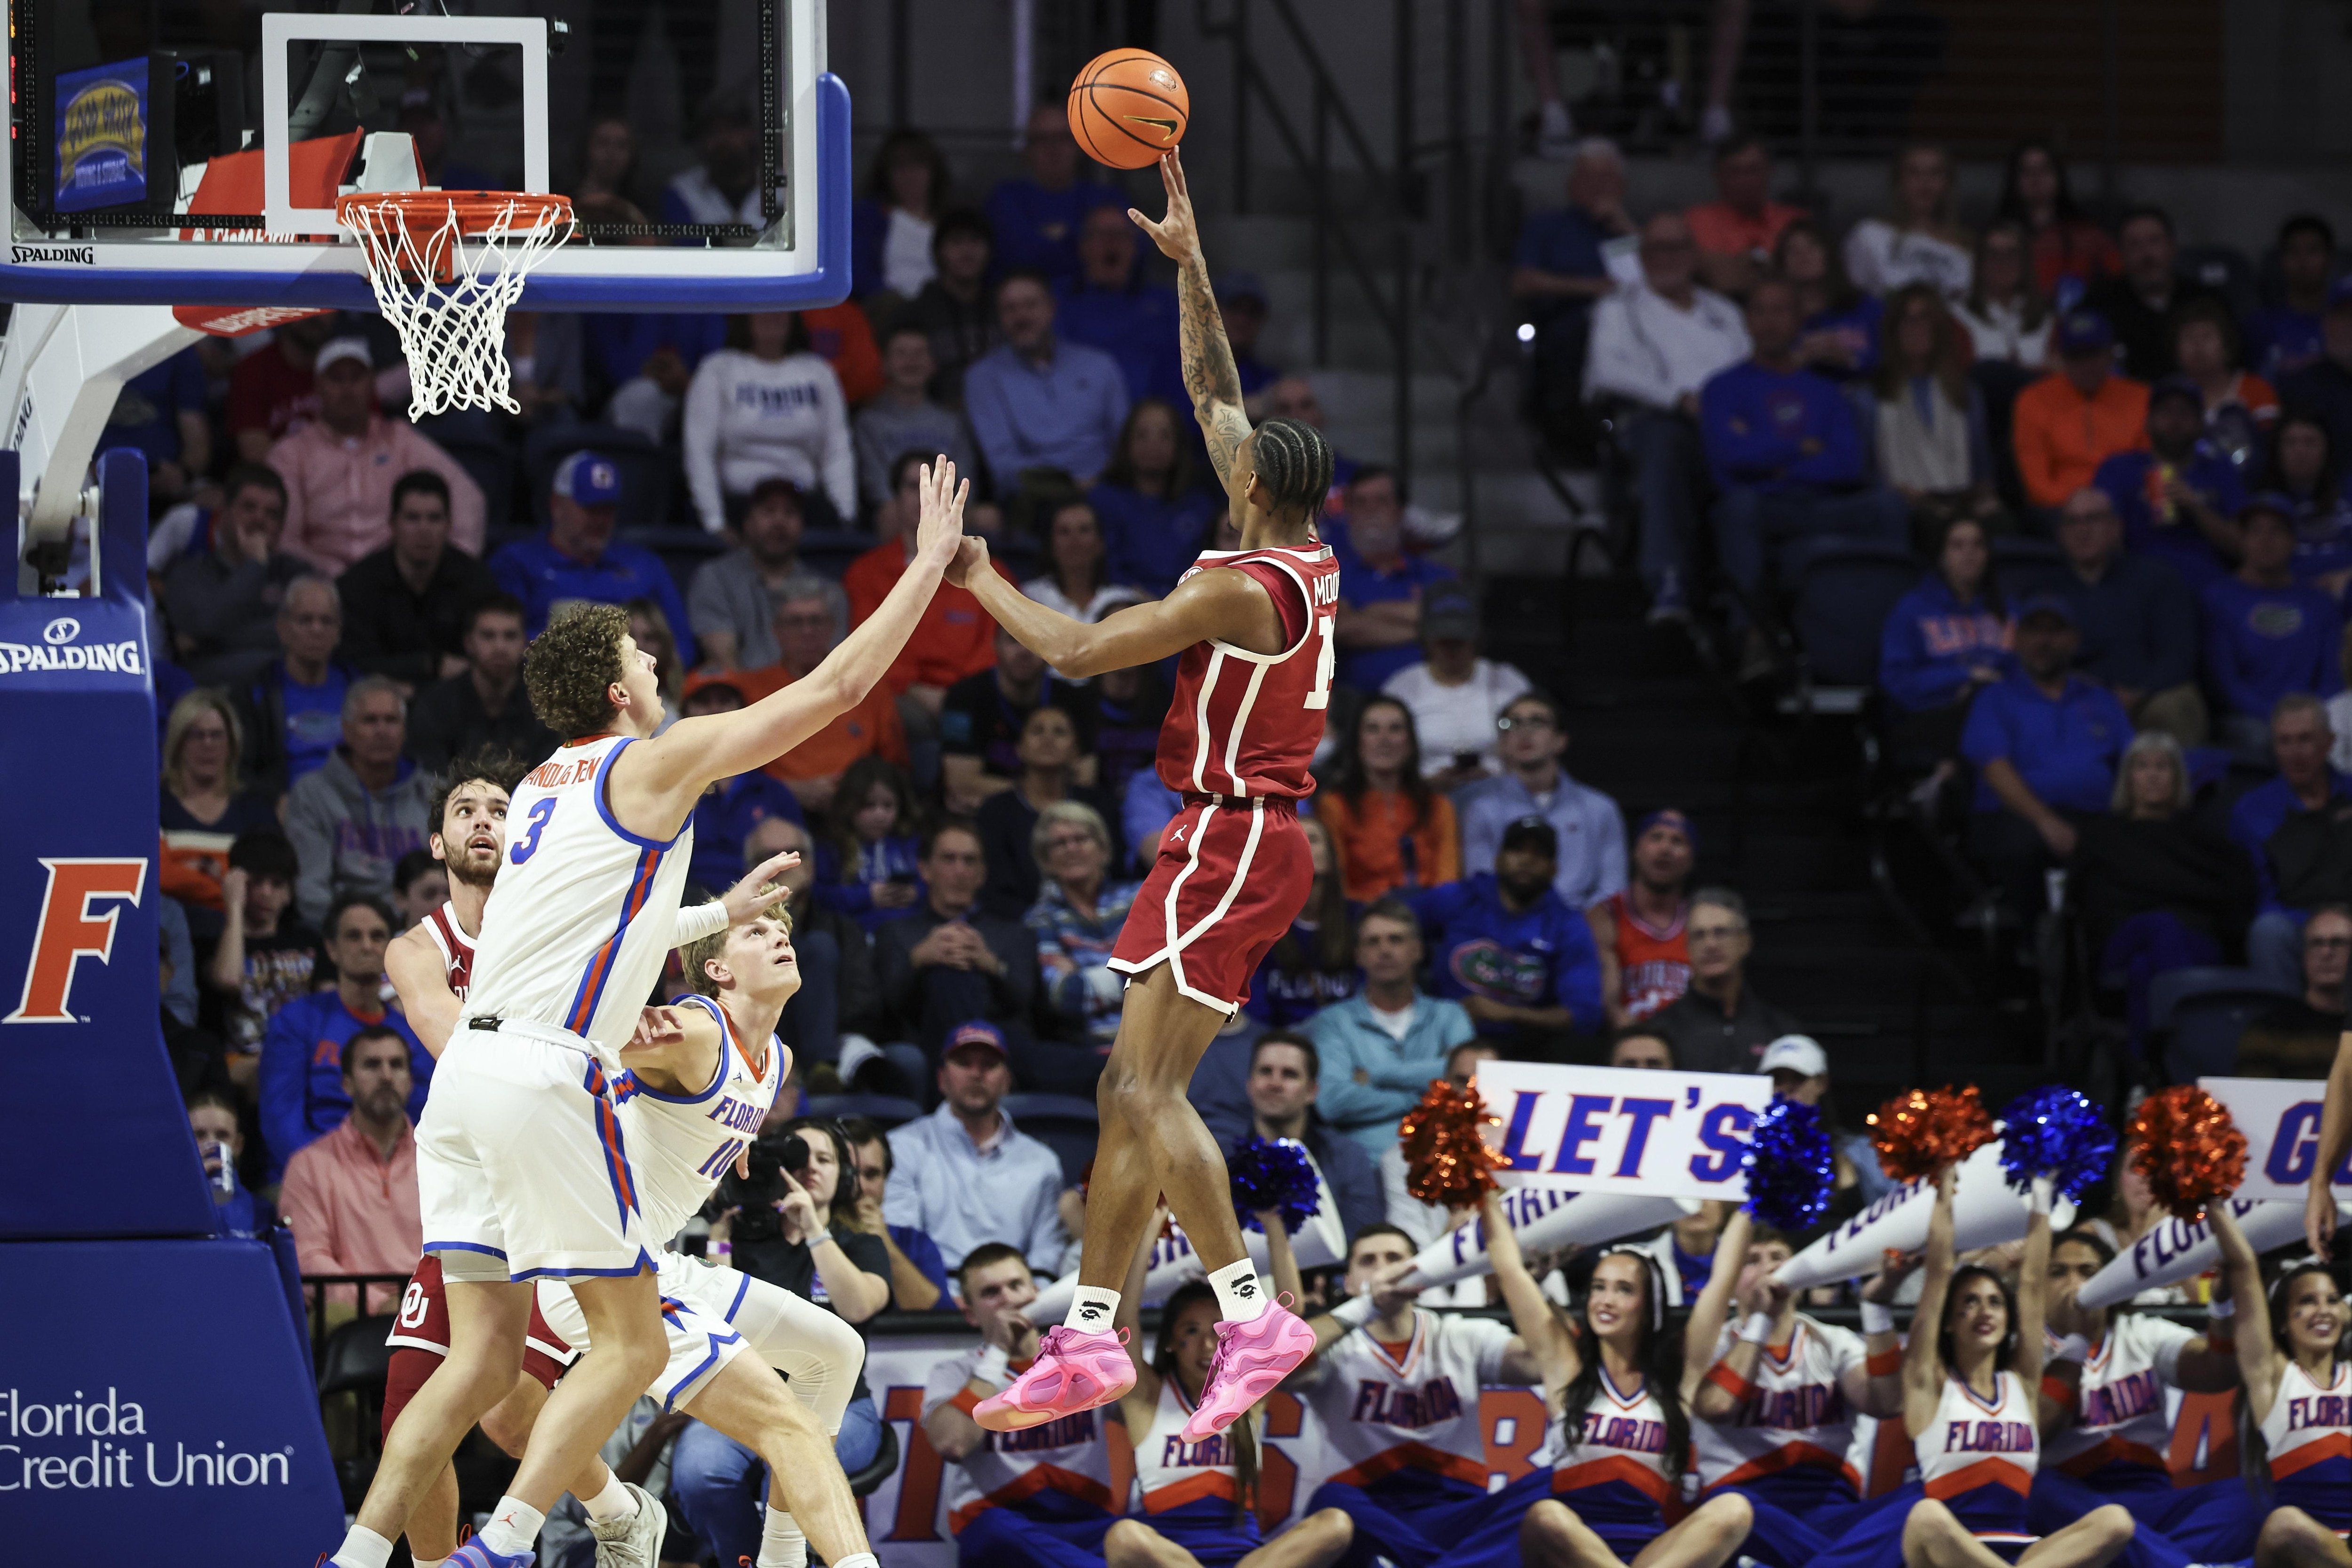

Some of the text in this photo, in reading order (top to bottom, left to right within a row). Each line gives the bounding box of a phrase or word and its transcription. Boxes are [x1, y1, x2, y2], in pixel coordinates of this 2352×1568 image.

[12, 246, 94, 265] SPALDING
[1313, 570, 1340, 607] MOO
[510, 797, 558, 865] 3
[1, 857, 149, 1024] F
[705, 1094, 768, 1134] FLORID
[1501, 1086, 1758, 1183] LET'S
[697, 1137, 743, 1180] 10
[1581, 1412, 1669, 1454] FLORID
